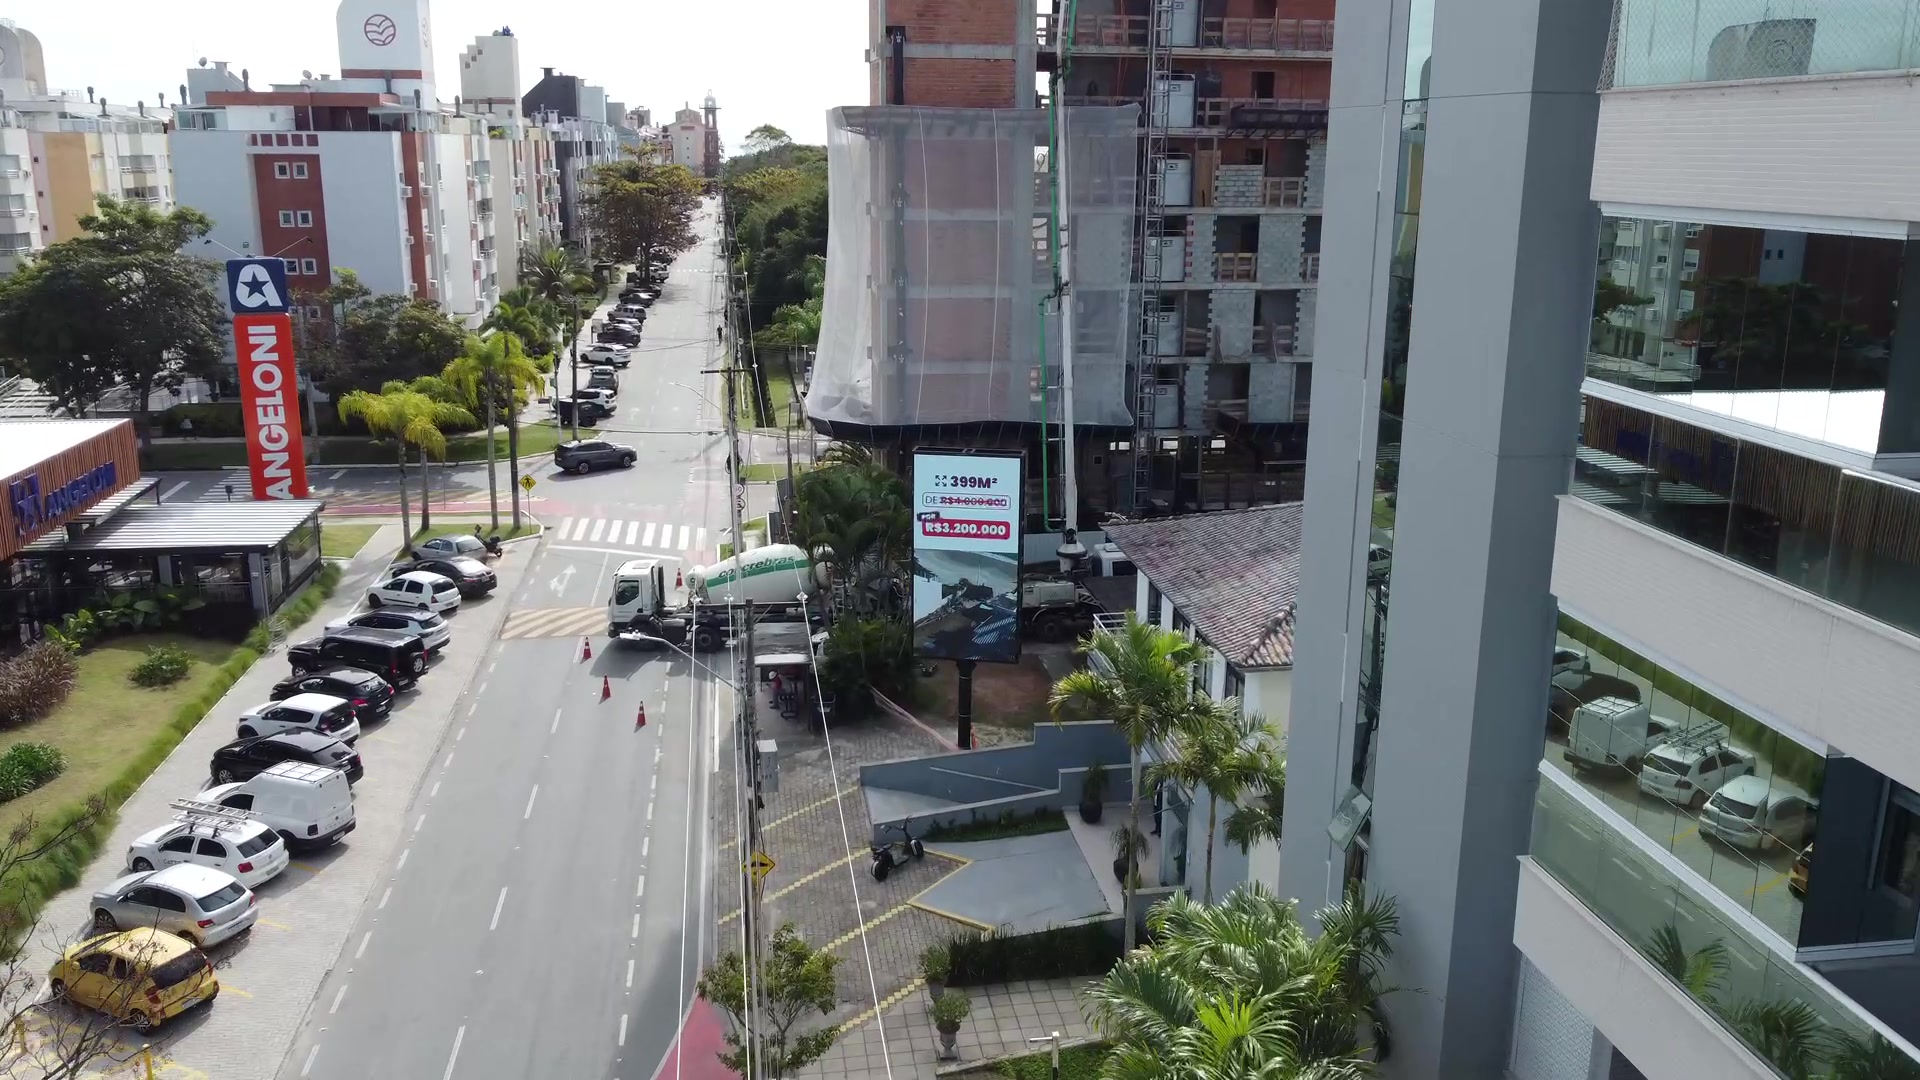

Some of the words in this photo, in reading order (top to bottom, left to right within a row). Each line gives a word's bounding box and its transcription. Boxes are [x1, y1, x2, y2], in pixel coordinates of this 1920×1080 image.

[247, 325, 294, 500] ANGELONI
[925, 495, 938, 504] DE
[925, 522, 1007, 536] R$3.200.000
[718, 555, 796, 578] cocrebras
